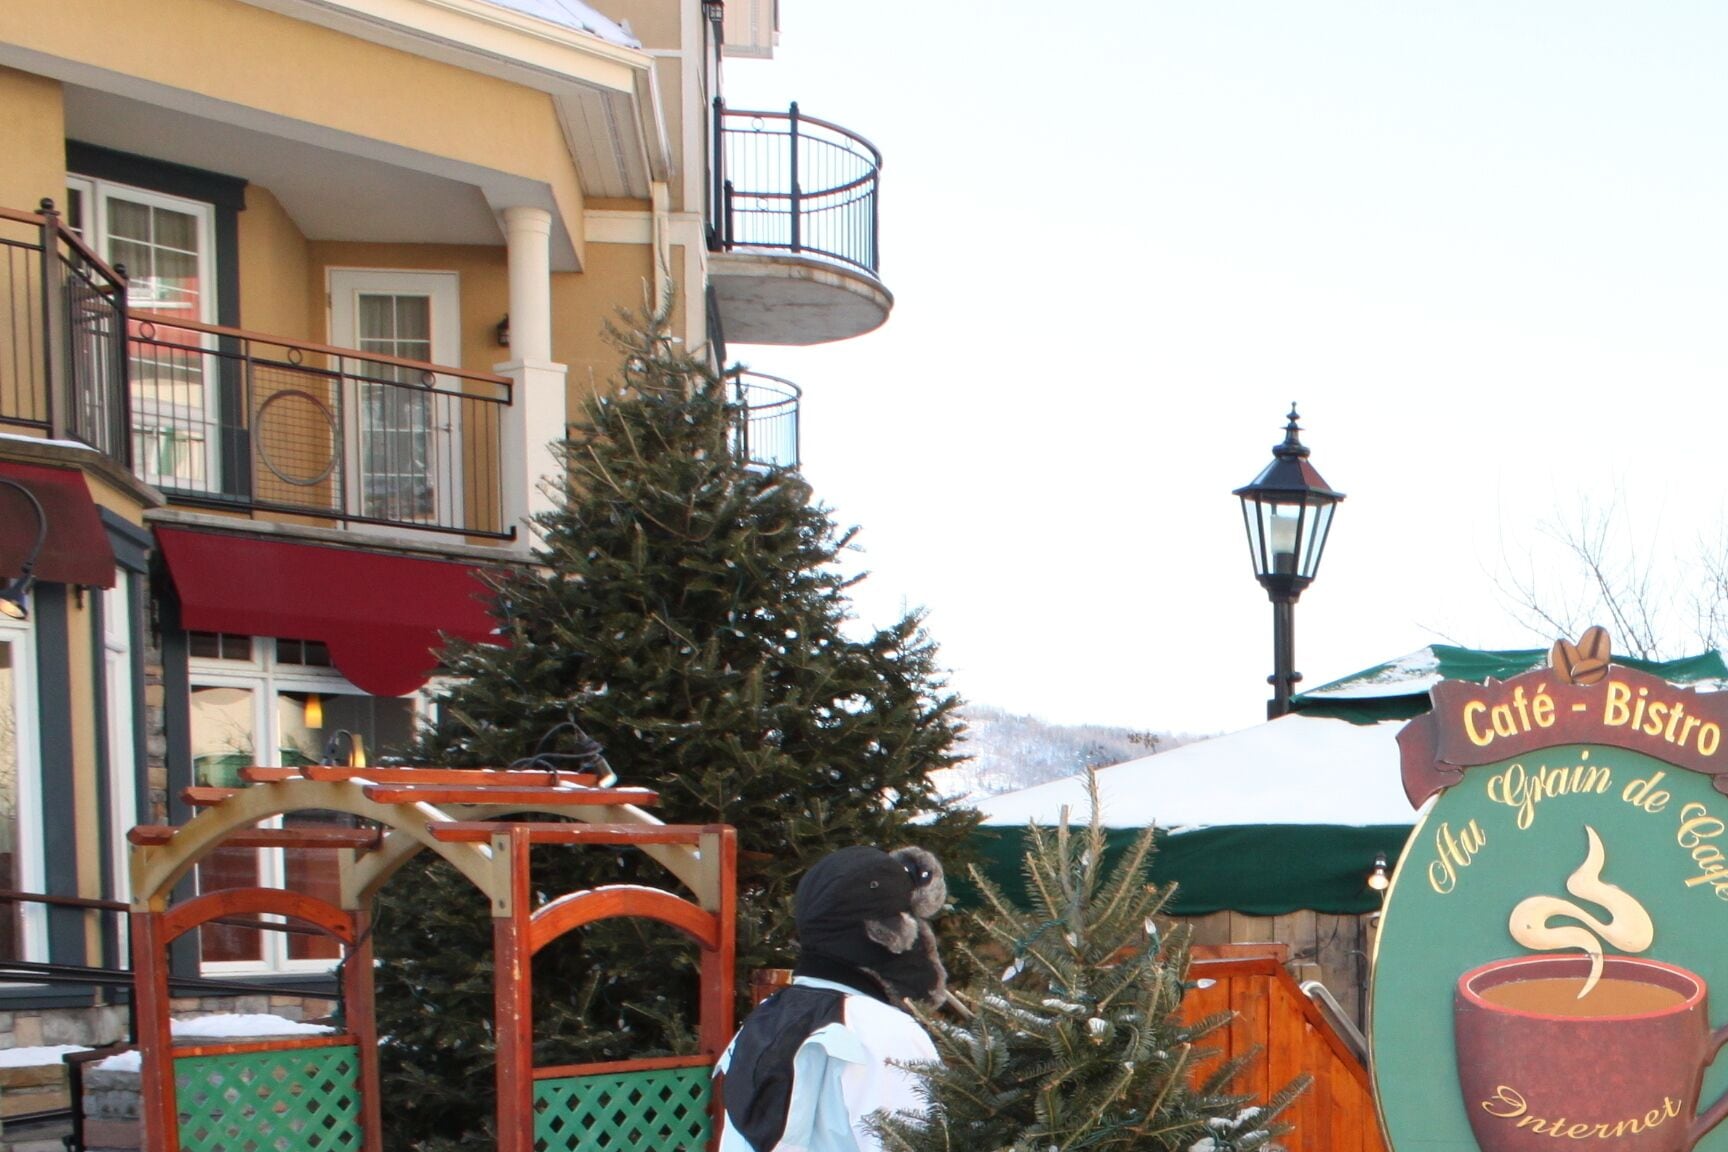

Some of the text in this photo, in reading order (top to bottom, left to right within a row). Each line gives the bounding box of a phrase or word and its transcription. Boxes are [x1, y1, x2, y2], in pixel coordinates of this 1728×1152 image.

[1463, 683, 1556, 747] Café
[1603, 681, 1721, 757] Bistro
[1428, 817, 1487, 895] Au
[1487, 750, 1613, 830] Grain
[1622, 770, 1671, 814] de
[1481, 1084, 1683, 1140] Internet
